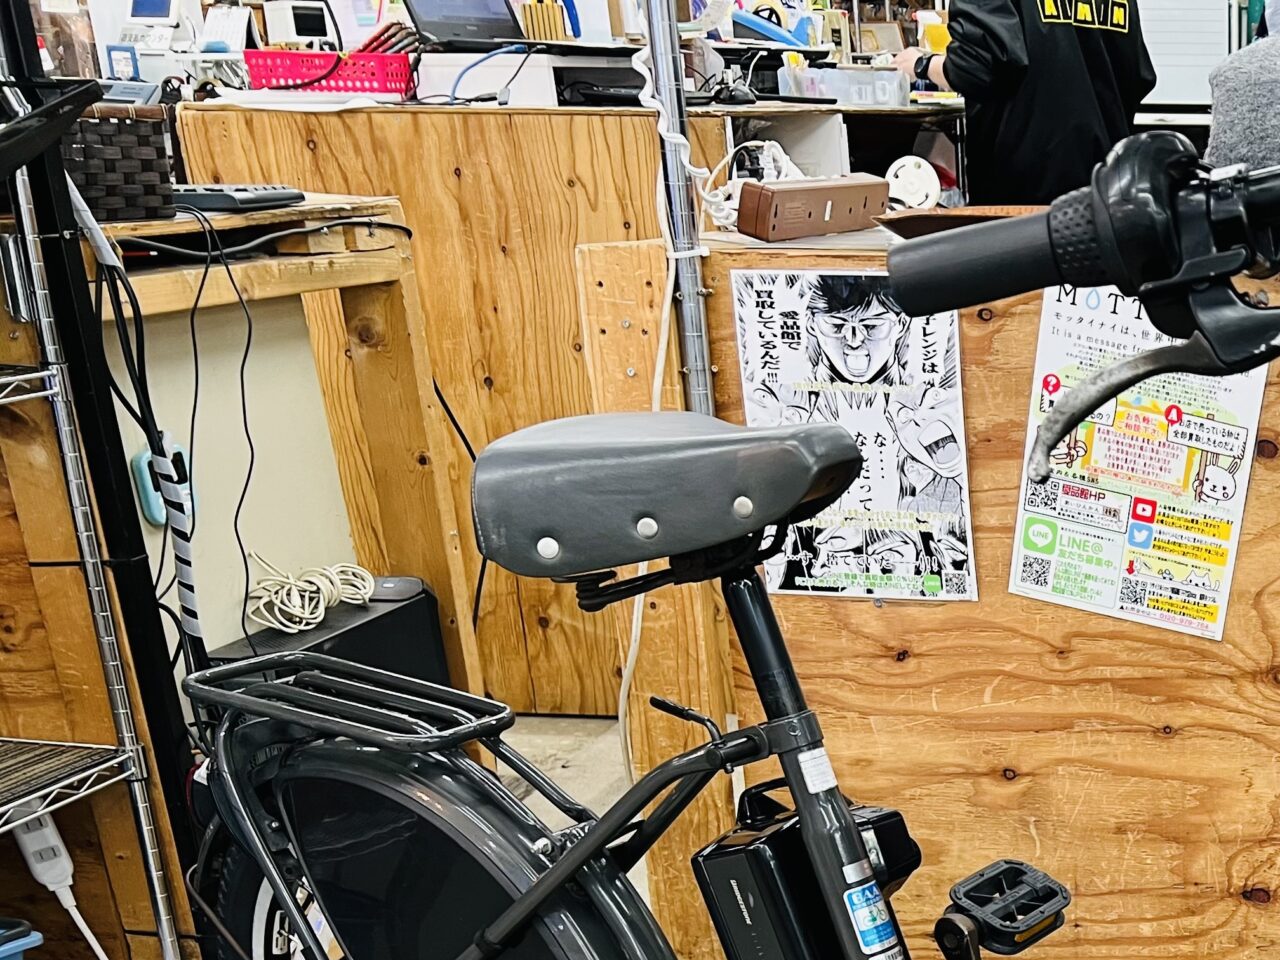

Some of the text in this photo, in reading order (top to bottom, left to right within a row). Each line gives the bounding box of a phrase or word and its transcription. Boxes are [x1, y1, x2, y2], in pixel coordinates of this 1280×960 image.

[1086, 334, 1129, 352] message
[1032, 529, 1050, 540] LINE
[851, 885, 881, 906] BAA
